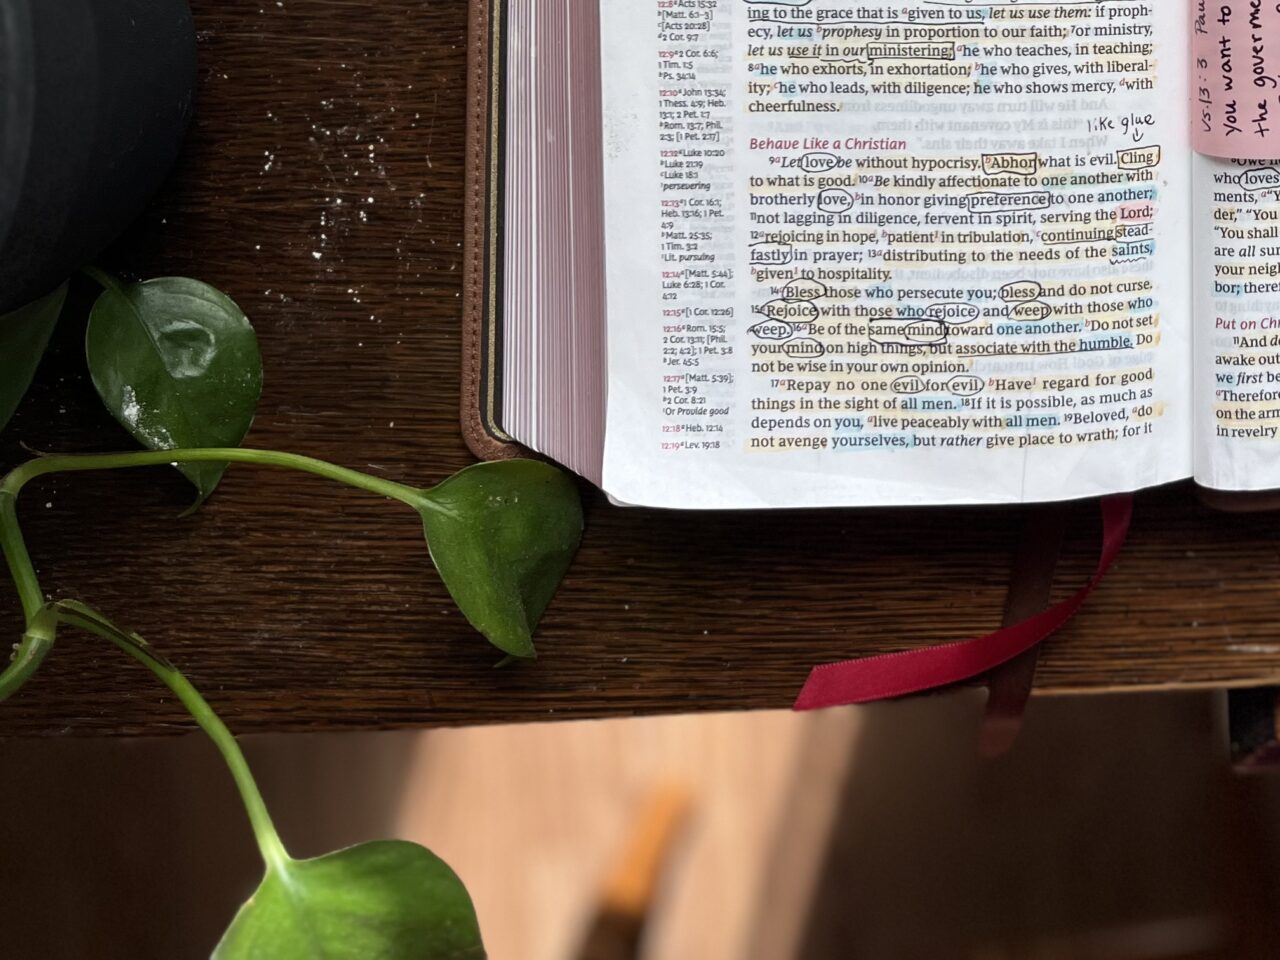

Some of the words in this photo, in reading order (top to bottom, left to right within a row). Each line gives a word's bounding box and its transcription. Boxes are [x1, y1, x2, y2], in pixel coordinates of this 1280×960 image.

[1213, 5, 1231, 26] to
[1217, 35, 1234, 91] want
[747, 99, 842, 113] cheerfulness.
[1120, 112, 1156, 135] glue
[1248, 99, 1273, 138] the
[749, 137, 800, 151] Behave
[803, 137, 829, 151] Like
[832, 140, 842, 151] a
[844, 137, 908, 151] Christian
[1215, 317, 1237, 331] Put
[1239, 320, 1257, 332] on
[751, 435, 775, 448] not
[778, 436, 828, 451] avenge
[831, 432, 910, 451] yourselves,
[913, 433, 937, 448] but
[940, 432, 983, 448] rather
[985, 432, 1016, 450] give
[1018, 431, 1056, 449] place
[1058, 430, 1074, 445] to
[1076, 426, 1120, 444] wrath;
[1122, 423, 1142, 439] for
[1143, 421, 1154, 435] it
[1216, 424, 1230, 438] in
[1231, 420, 1277, 439] revelry
